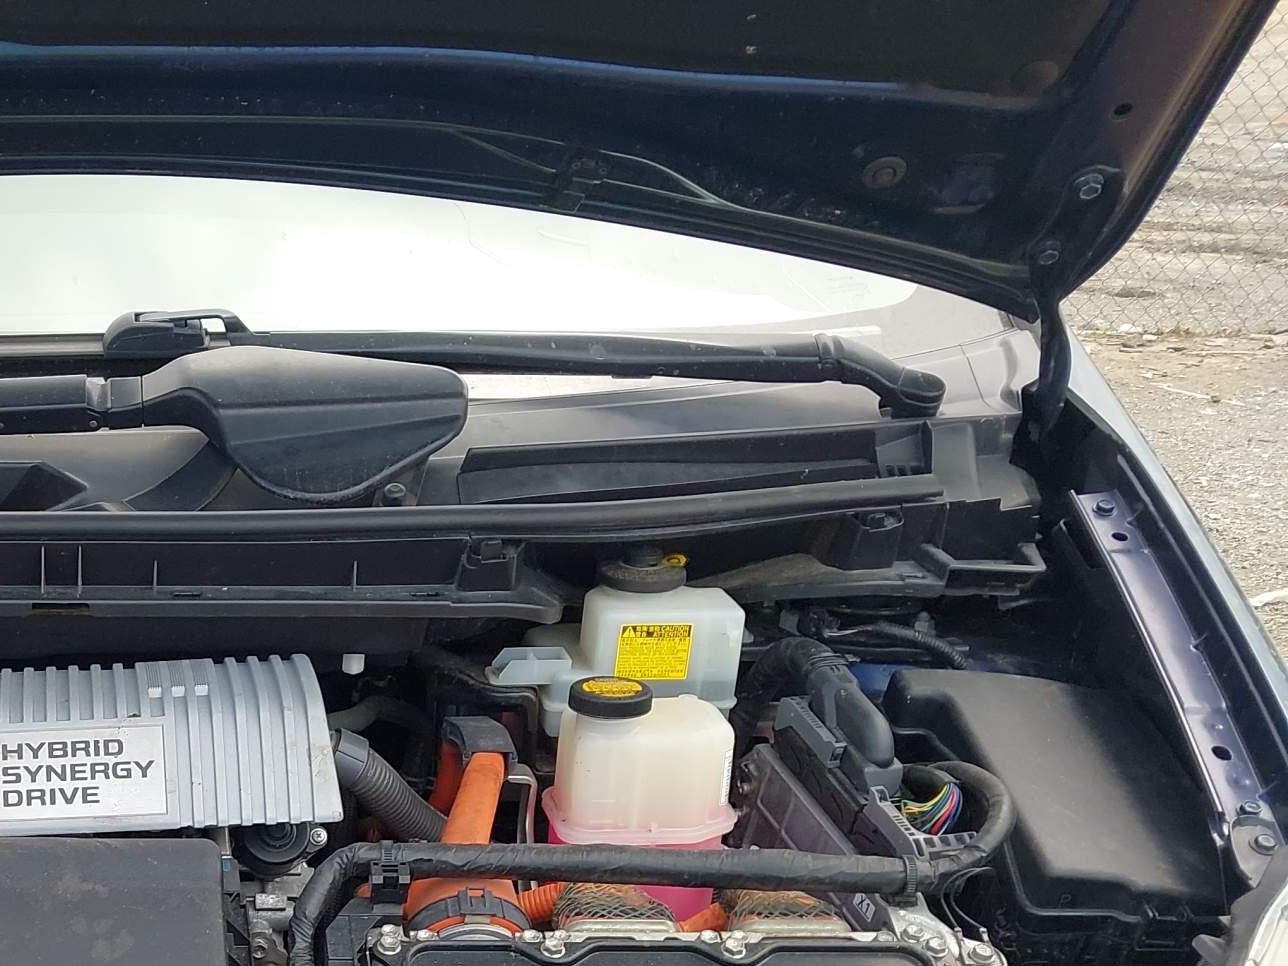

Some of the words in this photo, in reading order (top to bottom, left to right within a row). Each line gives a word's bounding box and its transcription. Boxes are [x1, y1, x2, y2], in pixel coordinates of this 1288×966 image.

[1, 738, 124, 761] HYBRID
[2, 759, 155, 784] SYNERGY
[2, 786, 100, 808] DRIVE
